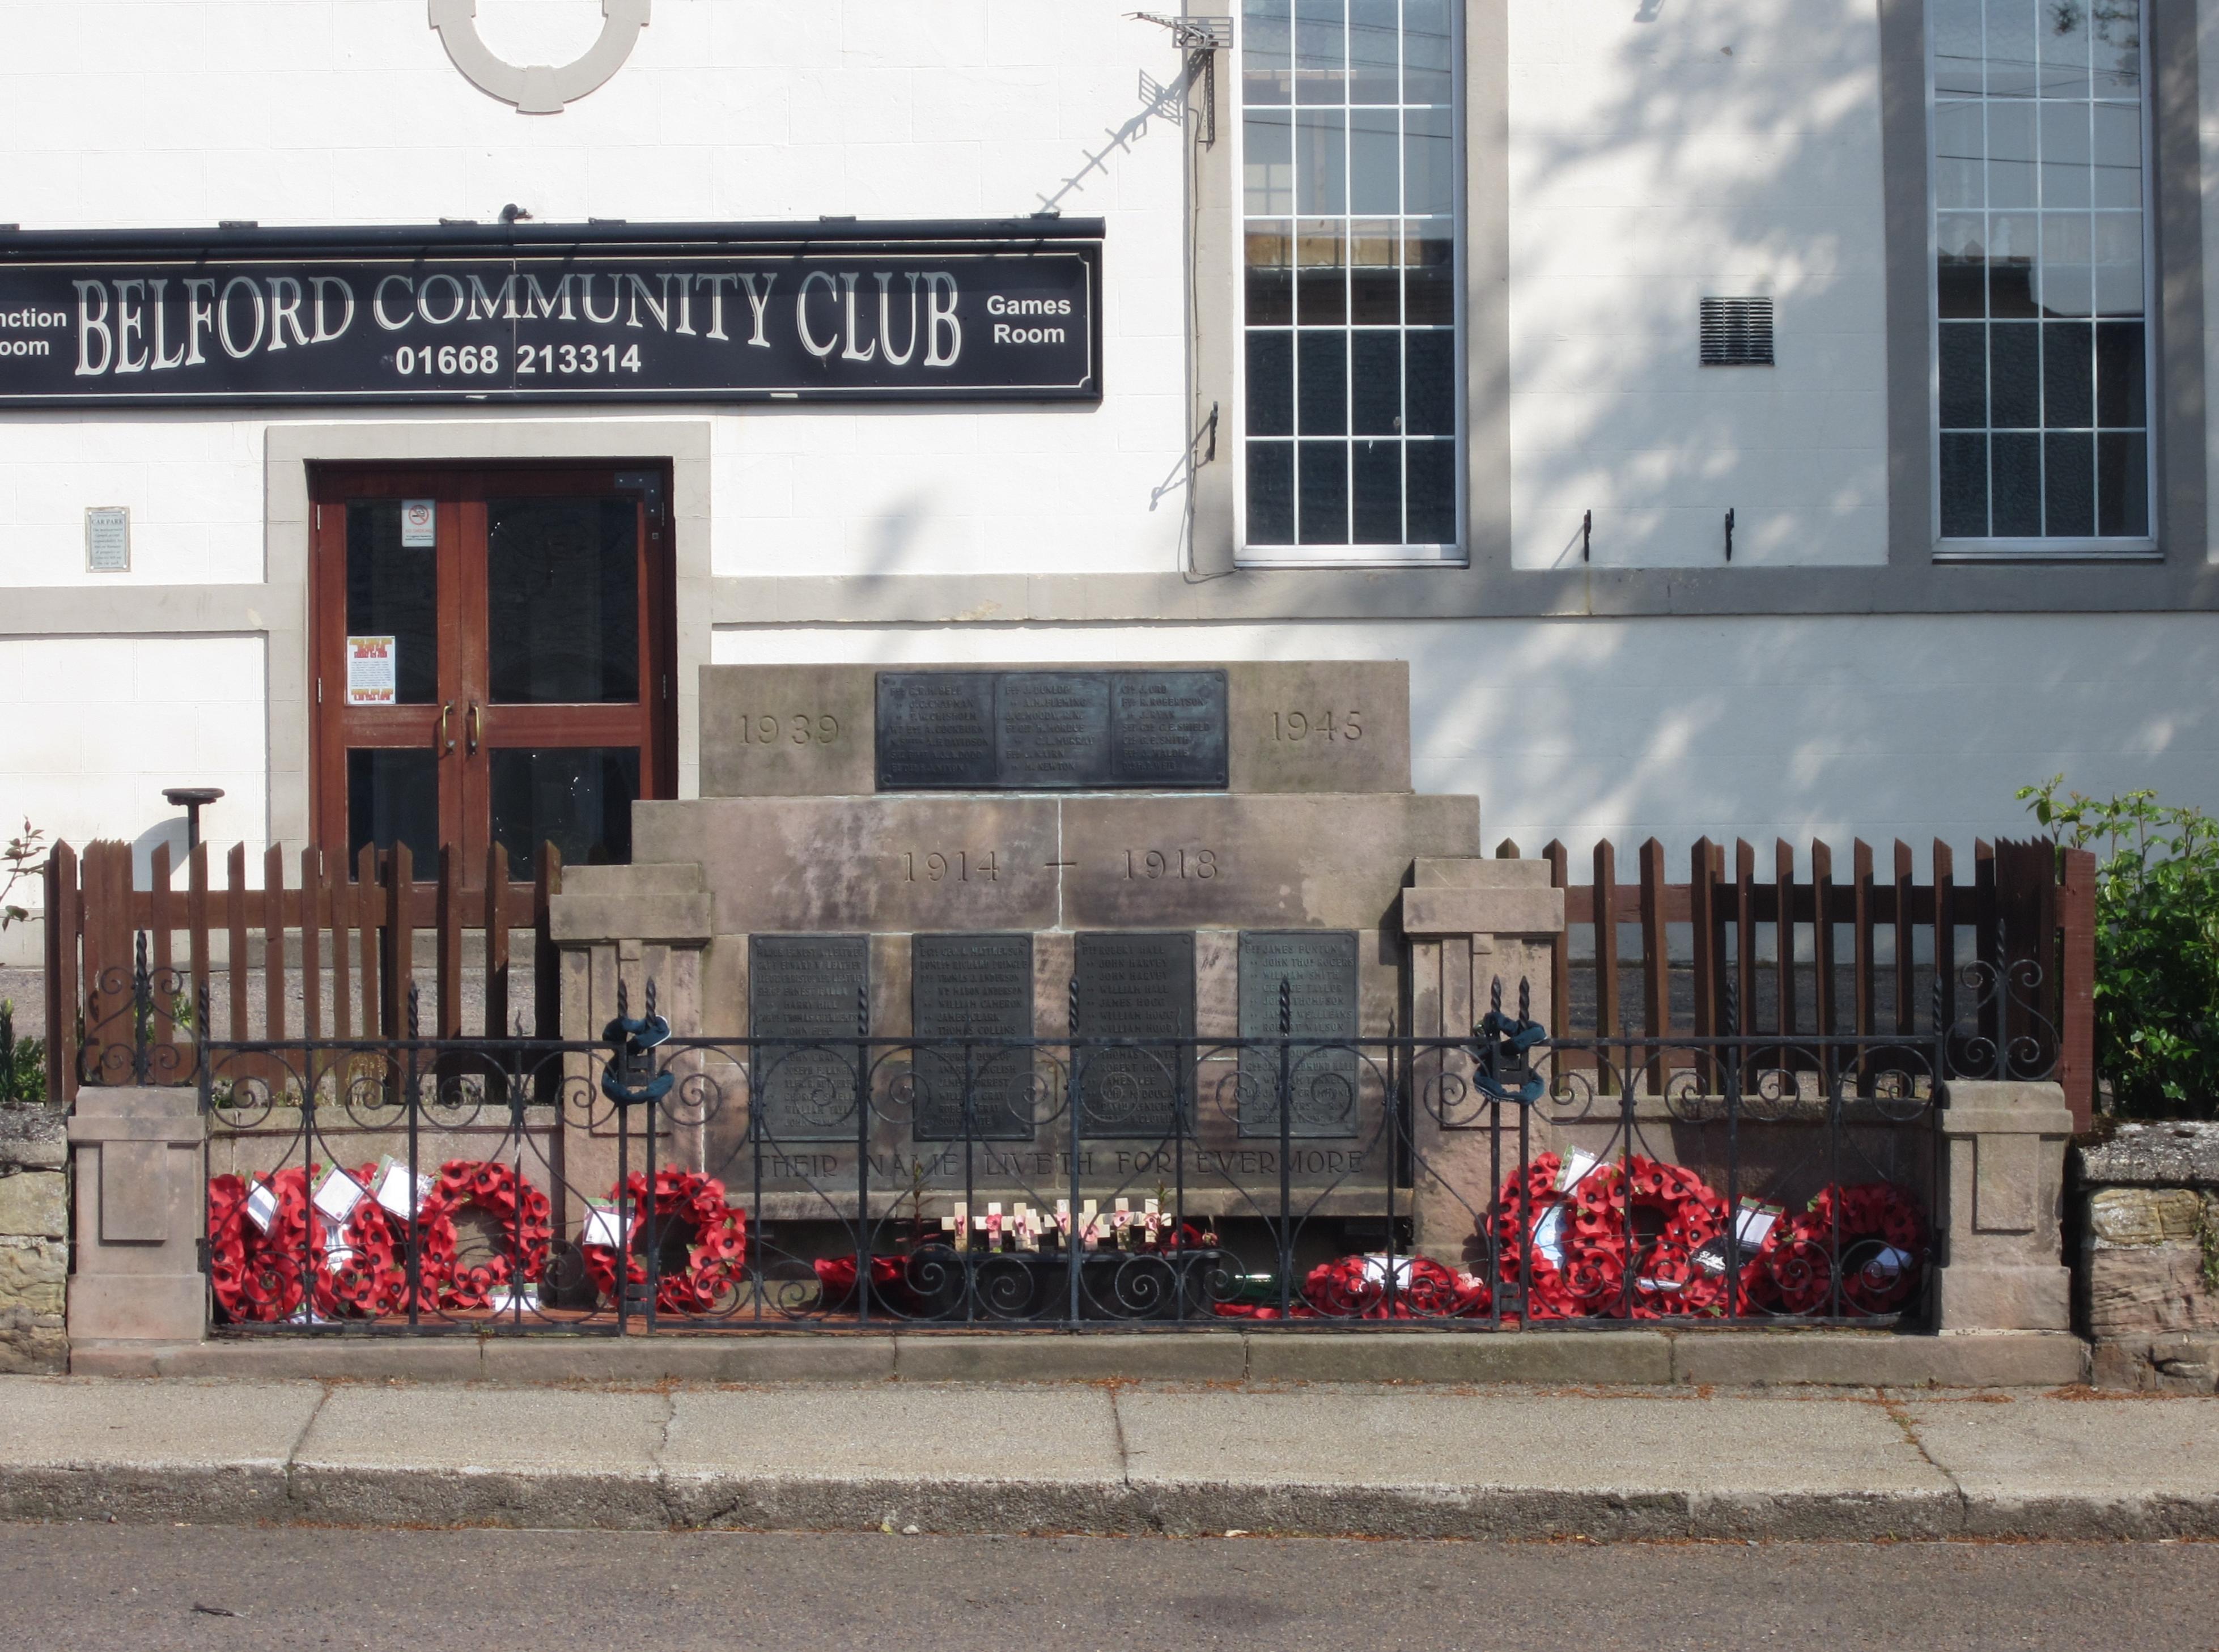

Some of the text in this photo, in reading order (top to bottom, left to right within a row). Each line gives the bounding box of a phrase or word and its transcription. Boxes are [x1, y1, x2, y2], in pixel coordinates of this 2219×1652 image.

[986, 295, 1071, 316] Games
[73, 270, 962, 377] BELFORD COMMUNITY CLUB
[993, 324, 1065, 344] Room
[0, 341, 50, 356] oom
[395, 344, 642, 375] 01668 213314
[740, 714, 838, 744] 1939
[1272, 711, 1363, 741] 1945
[903, 851, 999, 882] 1914
[1121, 850, 1217, 881] 1918
[753, 1150, 1365, 1178] THEIR NAME LIVETH FOR EVERMORE
